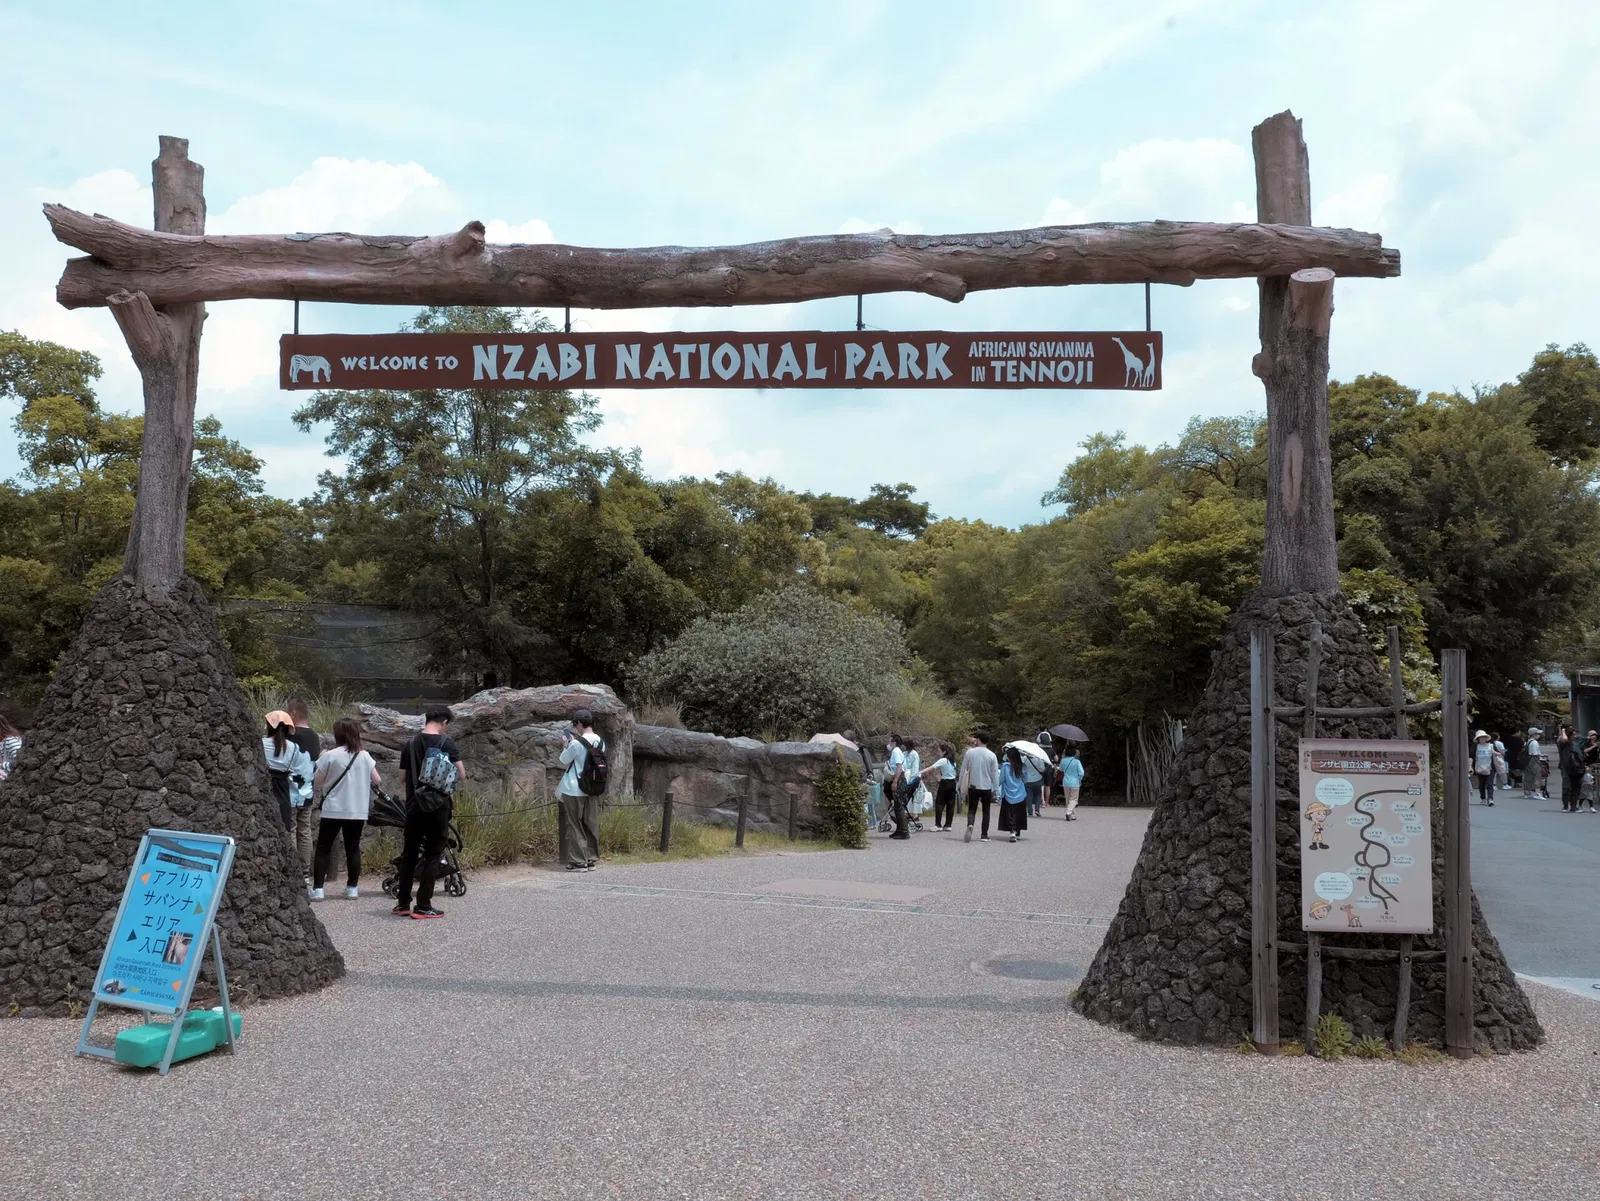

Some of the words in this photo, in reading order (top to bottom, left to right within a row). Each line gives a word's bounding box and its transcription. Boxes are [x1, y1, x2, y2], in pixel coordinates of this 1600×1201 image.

[968, 341, 1027, 358] AFRICAN
[1028, 341, 1095, 358] SAVANNA
[340, 355, 429, 371] WELCOME
[434, 355, 459, 371] TO
[472, 342, 597, 382] NZABI
[614, 341, 828, 381] NATIONAL
[844, 341, 954, 381] PARK
[971, 365, 986, 382] IN
[990, 360, 1093, 384] TENNOJI
[1339, 750, 1389, 759] WELCOME
[153, 869, 204, 889] アフリカ
[143, 890, 194, 911] サバンナ
[141, 915, 181, 932] エリア
[138, 936, 167, 955] 入口
